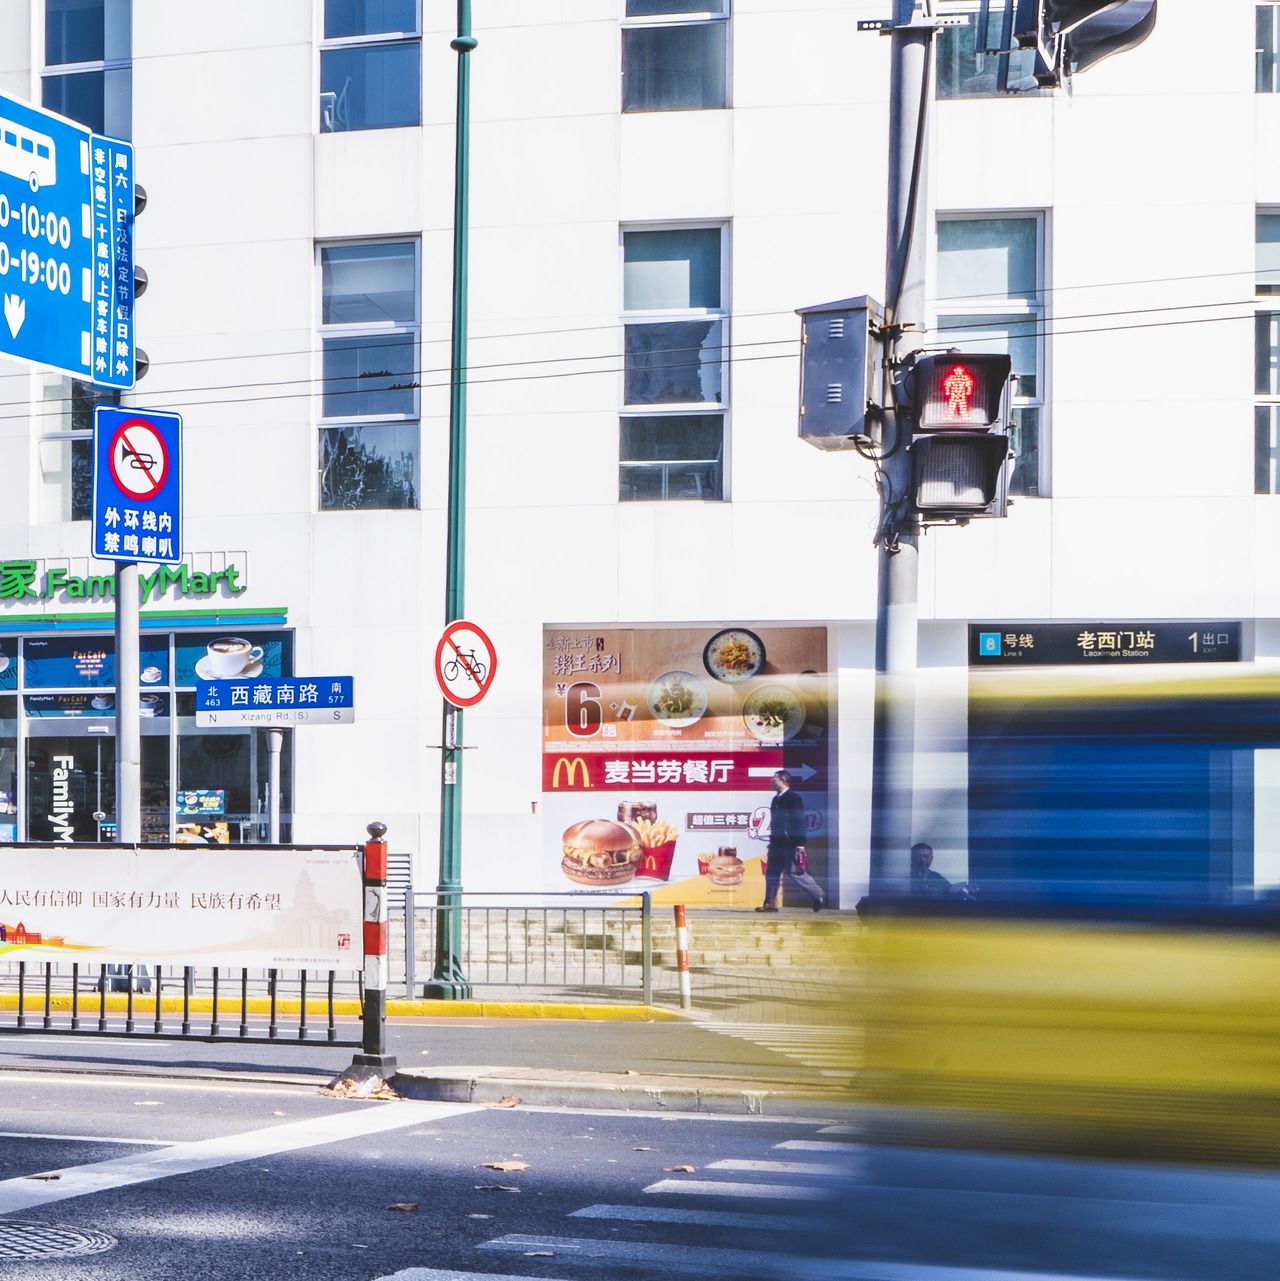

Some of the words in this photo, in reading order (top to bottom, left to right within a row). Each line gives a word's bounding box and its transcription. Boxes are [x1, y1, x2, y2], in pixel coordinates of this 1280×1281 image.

[115, 153, 129, 377] 周六、日及法定节假日除外
[104, 507, 173, 533] 外环线内
[104, 532, 174, 558] 禁鸣喇叭
[47, 564, 239, 604] FamyMart
[985, 636, 996, 650] 8
[1003, 634, 1034, 649] 号线
[1077, 631, 1155, 650] 老西门站
[1188, 632, 1198, 653] 1
[1202, 633, 1228, 646] 出口
[205, 699, 221, 707] 463
[208, 686, 218, 696] 北
[229, 683, 319, 705] 西藏南路
[331, 682, 342, 694] 南
[209, 714, 217, 723] N
[241, 713, 272, 721] Xizang
[333, 711, 341, 720] S
[604, 760, 735, 784] 麦当劳餐厅
[0, 889, 82, 907] 人民有信仰
[92, 891, 180, 909] 国家有力量
[191, 893, 282, 911] 民族有希望
